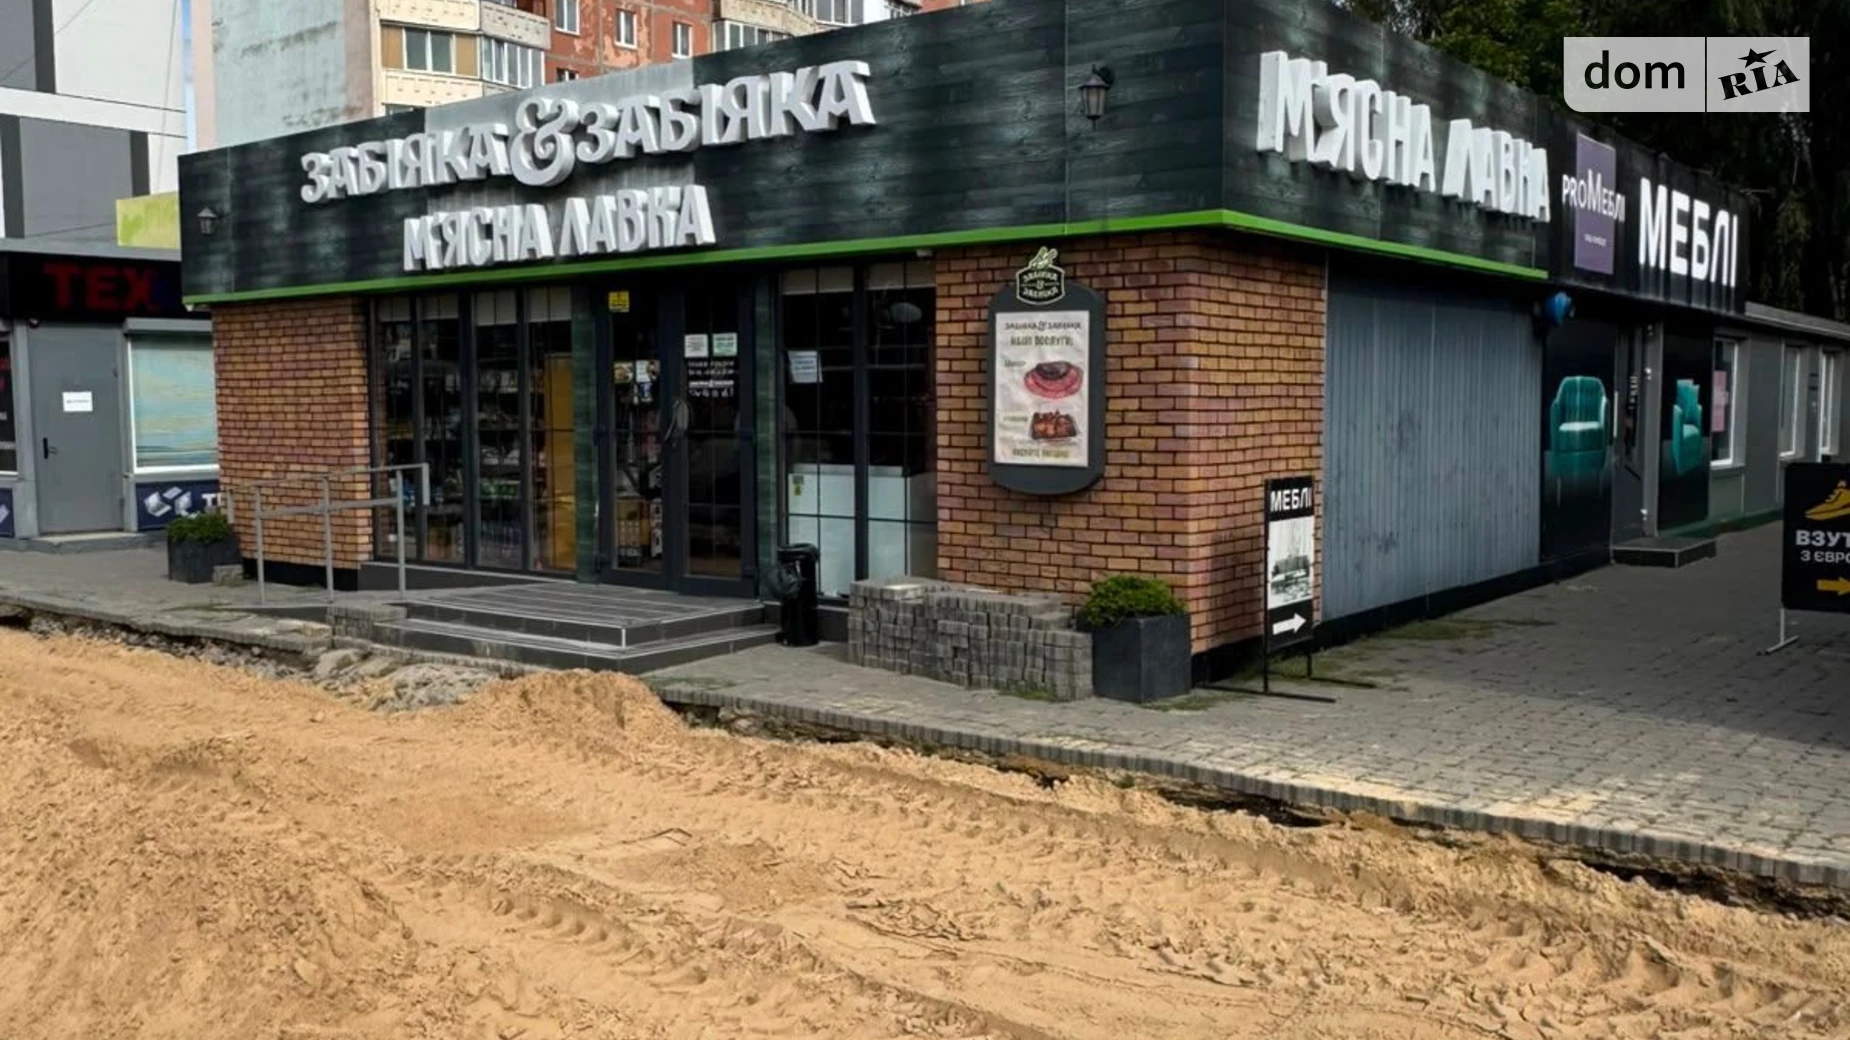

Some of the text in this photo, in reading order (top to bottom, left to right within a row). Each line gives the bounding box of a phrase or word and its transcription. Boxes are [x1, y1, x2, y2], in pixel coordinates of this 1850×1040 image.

[1442, 118, 1551, 223] ЛАВКА
[558, 184, 717, 256] ЛАВКА
[1638, 176, 1738, 289] МЕБЛІ
[1270, 487, 1312, 512] МЕБЛІ
